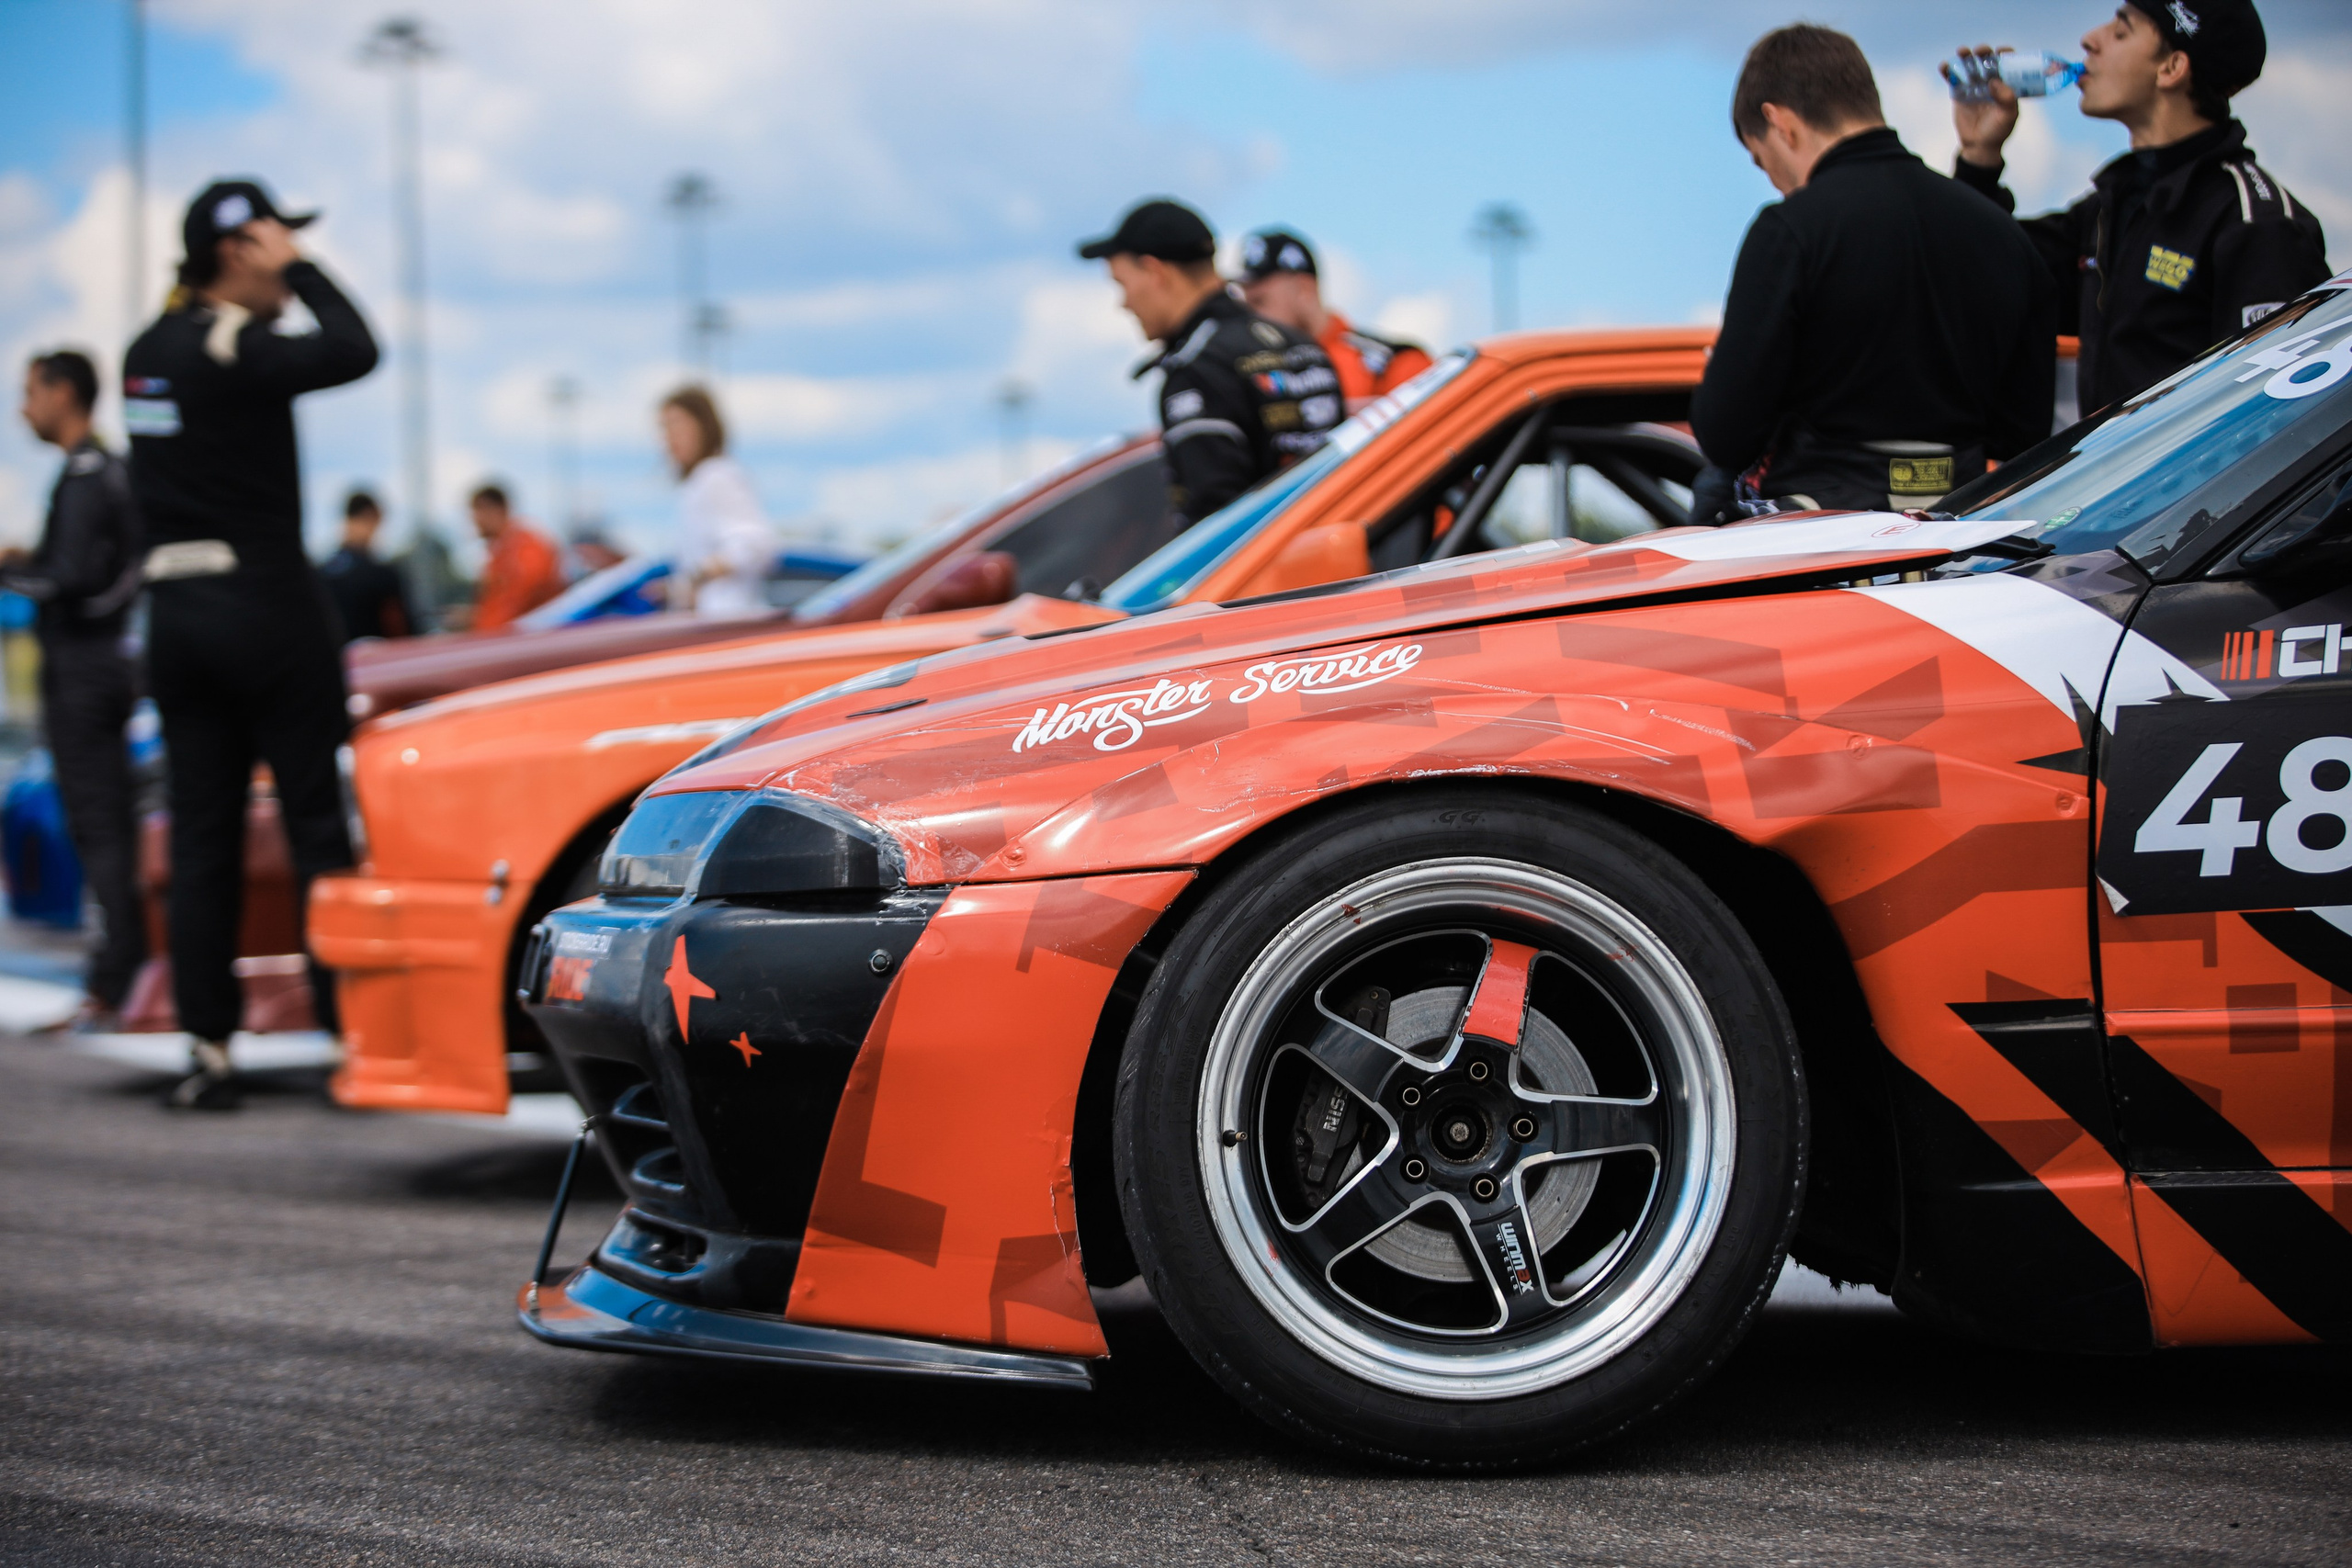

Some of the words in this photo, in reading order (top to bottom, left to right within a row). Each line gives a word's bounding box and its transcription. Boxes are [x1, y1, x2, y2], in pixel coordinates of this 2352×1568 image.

[1012, 679, 1213, 753] Monster
[1229, 643, 1422, 704] Service
[2134, 736, 2352, 876] 48
[1496, 1233, 1519, 1292] WHEELS
